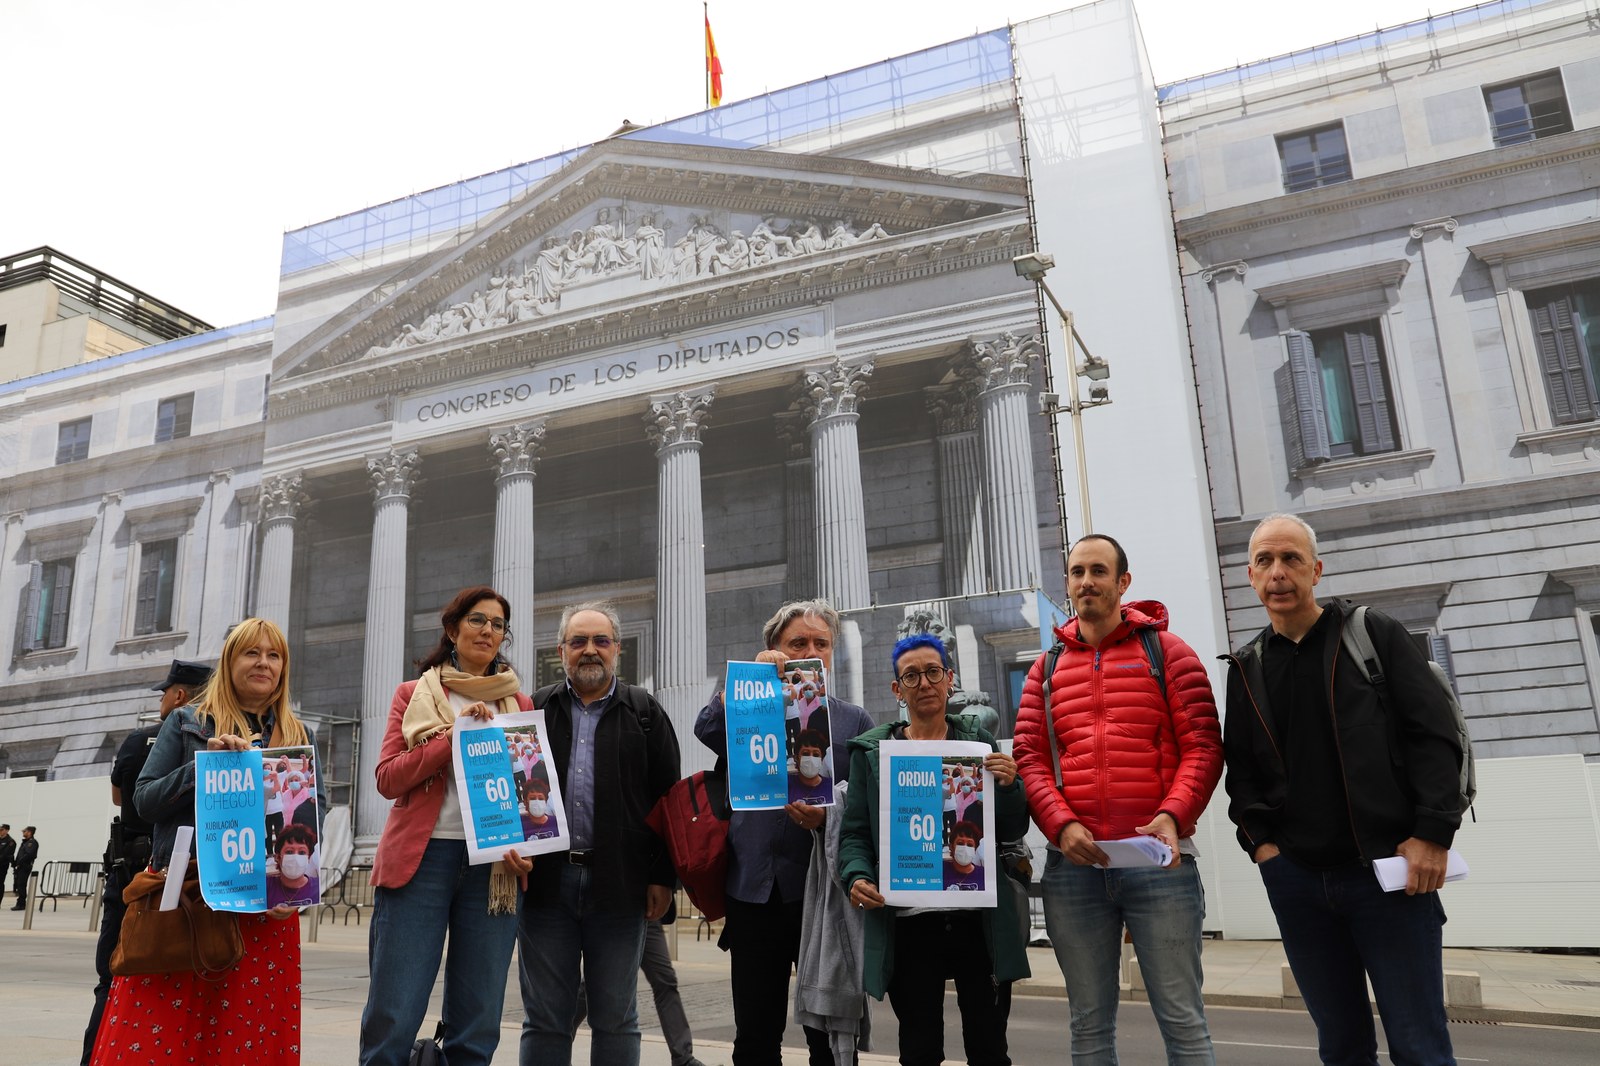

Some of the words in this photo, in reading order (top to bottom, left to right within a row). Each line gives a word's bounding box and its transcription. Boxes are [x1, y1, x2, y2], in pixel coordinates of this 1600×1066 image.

[417, 383, 531, 422] CONGRESO
[549, 373, 576, 395] DE
[594, 361, 637, 386] LOS
[657, 327, 800, 373] DIPUTADOS
[734, 680, 776, 700] HORA
[735, 700, 749, 716] ES
[753, 699, 777, 714] ARA
[467, 740, 503, 757] ORDUA
[750, 733, 779, 764] 60
[205, 756, 212, 769] A
[215, 755, 242, 768] NOSA
[766, 764, 778, 775] JA!
[205, 767, 256, 794] HORA
[898, 770, 937, 787] ORDUA
[485, 776, 510, 803] 60
[205, 791, 257, 811] CHEGOU
[205, 819, 239, 831] XUBILACIÓN
[910, 814, 936, 841] 60
[205, 833, 217, 842] AOS
[222, 827, 256, 863] 60
[922, 842, 936, 852] ¡YA!
[239, 862, 254, 875] XA!
